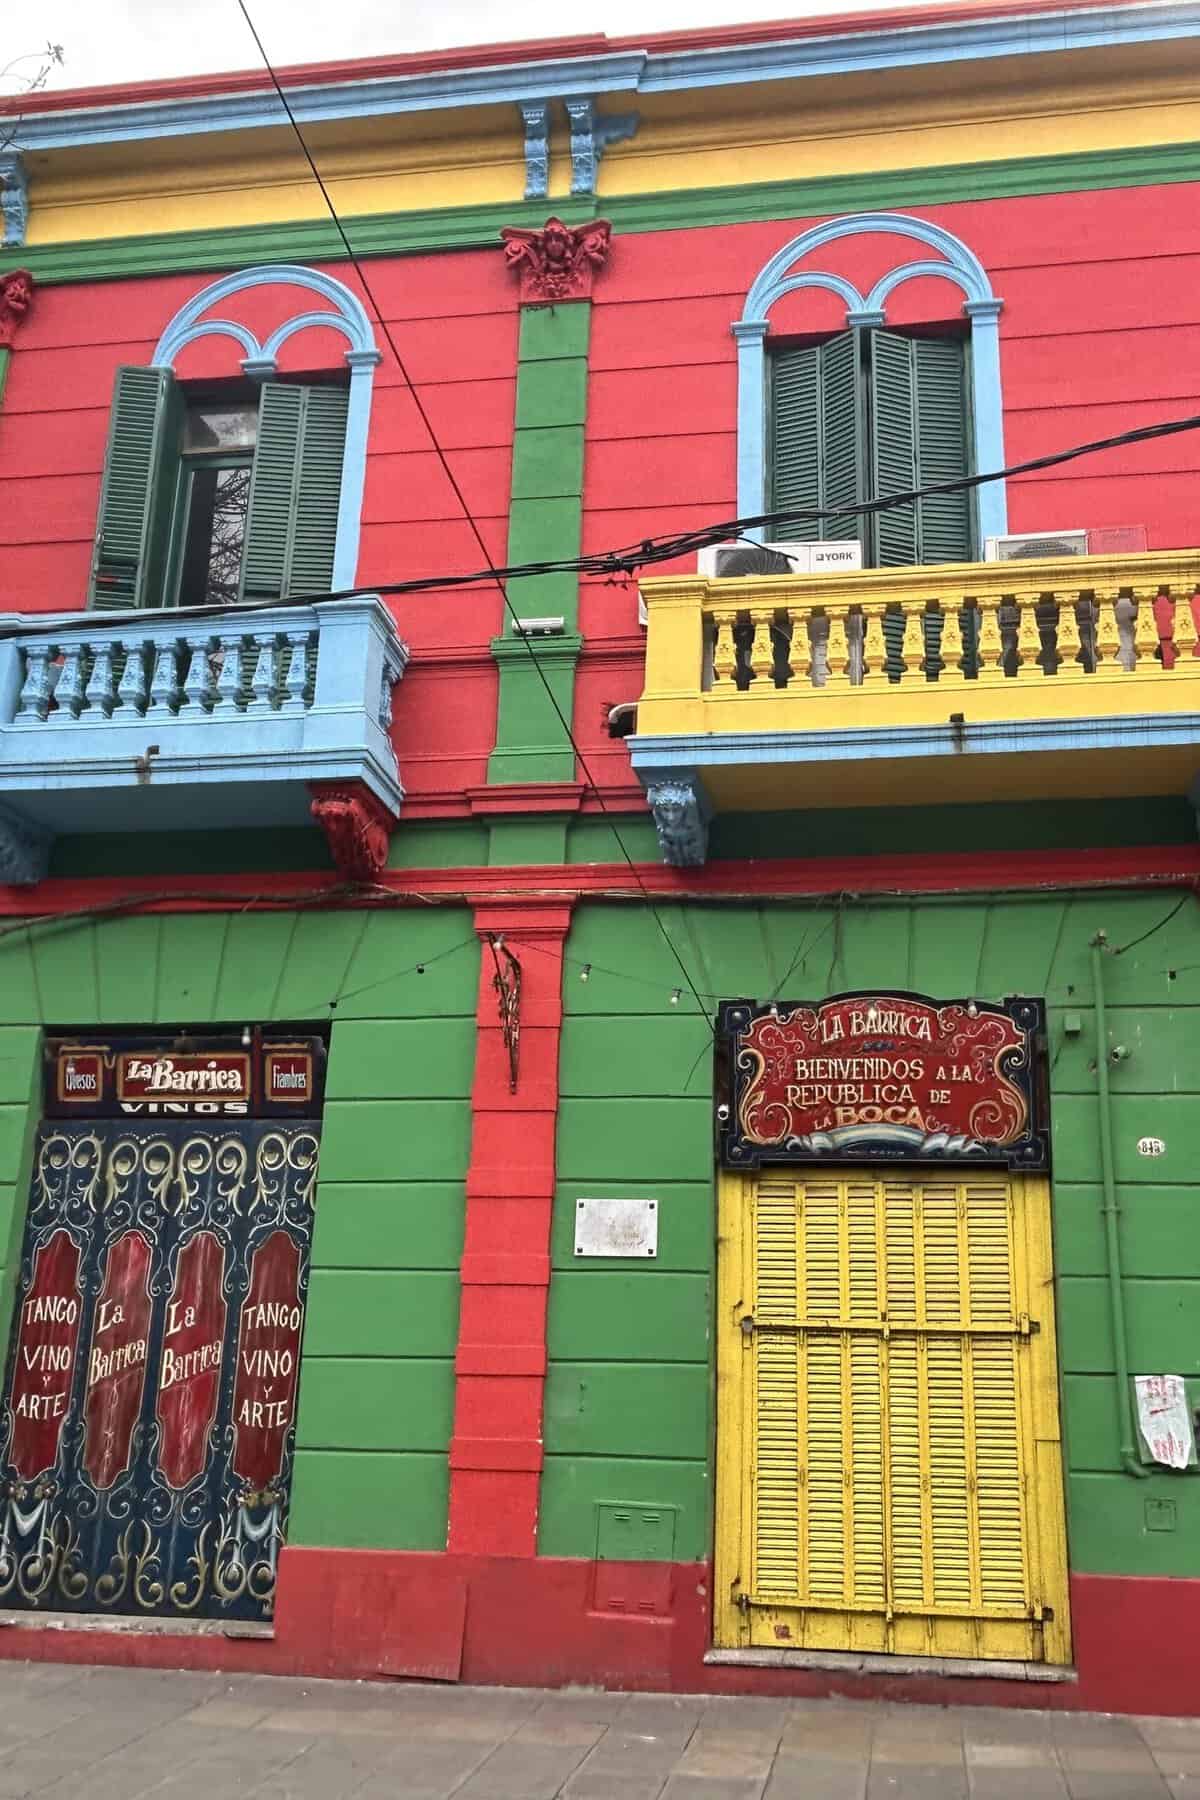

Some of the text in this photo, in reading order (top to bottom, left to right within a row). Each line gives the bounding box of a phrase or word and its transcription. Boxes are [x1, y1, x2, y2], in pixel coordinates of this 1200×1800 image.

[824, 551, 853, 561] YORK
[821, 1011, 932, 1042] LA BARRICA
[125, 1058, 243, 1093] La Barrica
[796, 1058, 972, 1081] BIENVENIDOS A LA
[120, 1102, 249, 1114] VINOS
[785, 1084, 950, 1110] REPUBLICA DE
[814, 1106, 926, 1130] LA BOCA
[25, 1296, 77, 1325] TANGO
[96, 1298, 125, 1335] La
[166, 1300, 196, 1337] La
[243, 1302, 300, 1331] TANGO
[23, 1344, 71, 1371] VINO
[90, 1338, 146, 1386] Barrica
[160, 1340, 222, 1390] Barrica
[242, 1349, 292, 1378] VINO
[42, 1375, 52, 1388] Y
[263, 1385, 273, 1399] Y
[16, 1391, 66, 1420] ARTE
[238, 1399, 289, 1429] ARTE
